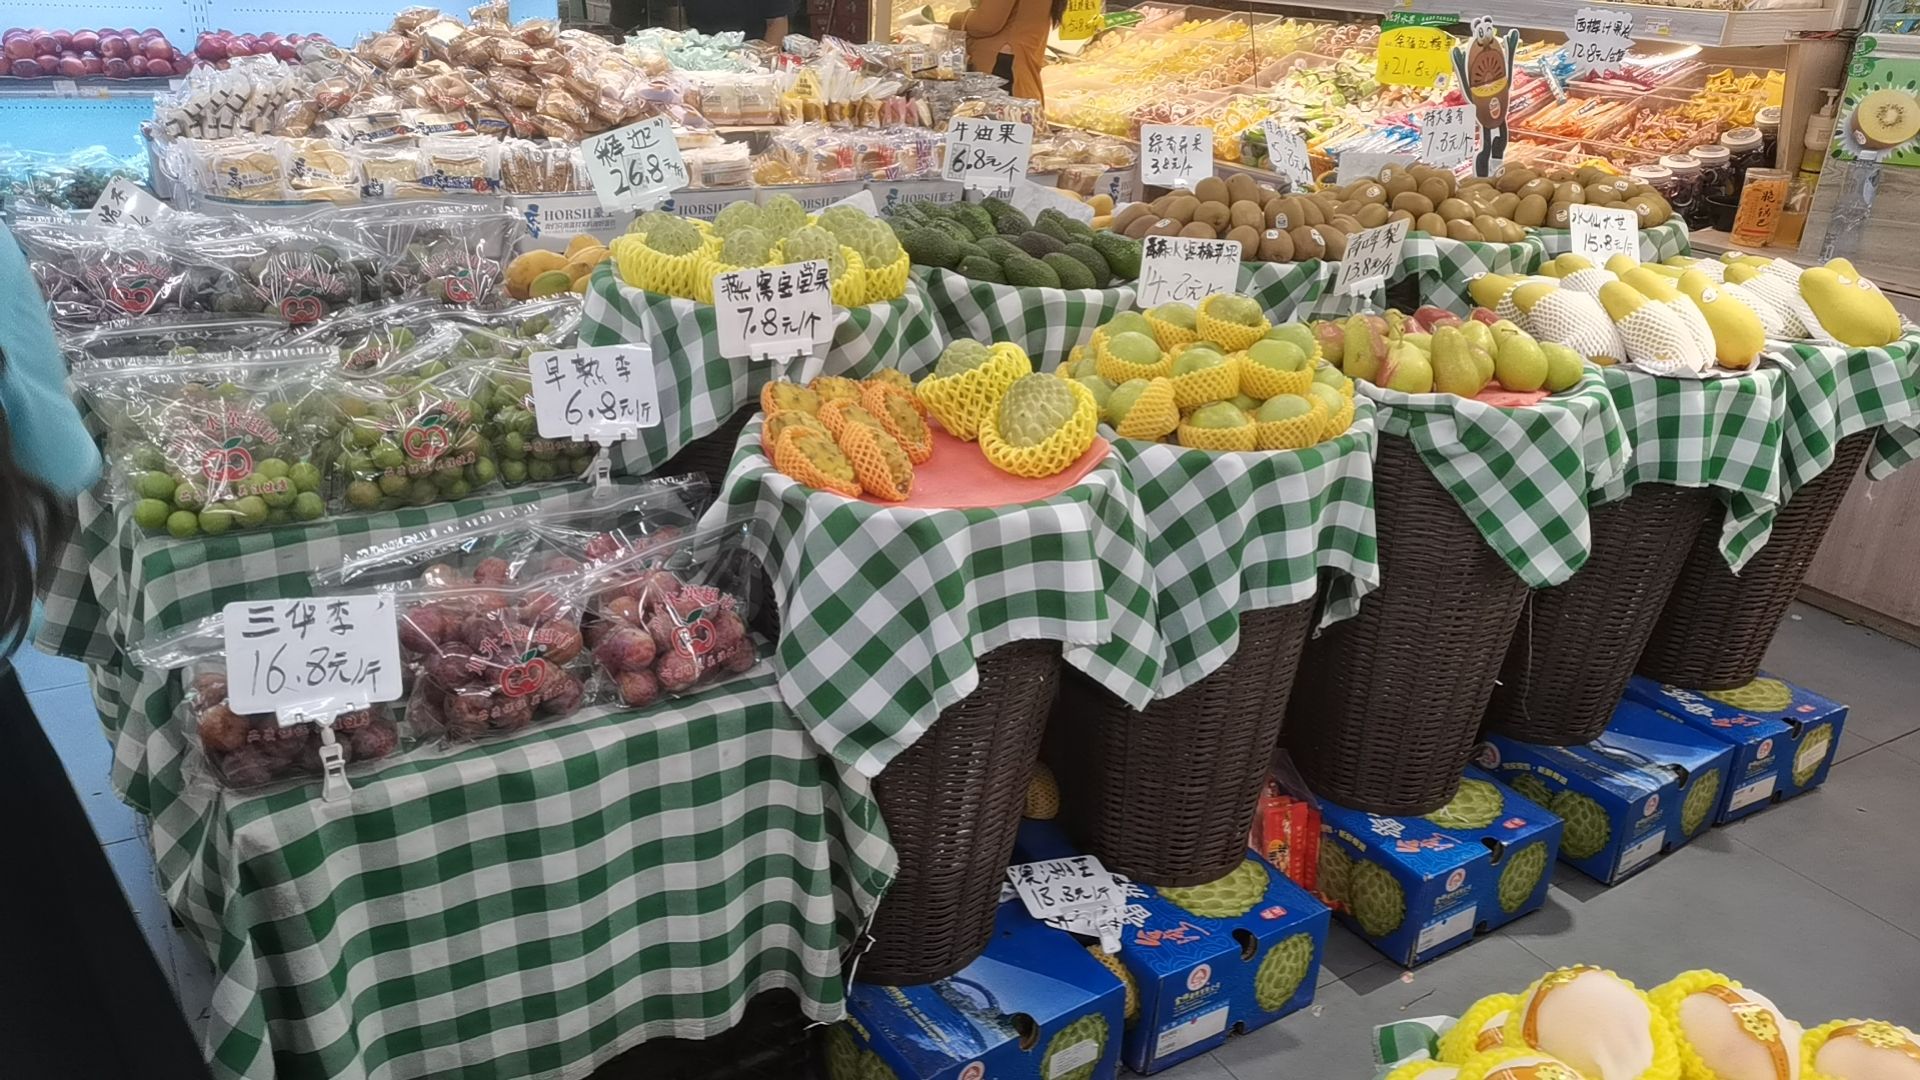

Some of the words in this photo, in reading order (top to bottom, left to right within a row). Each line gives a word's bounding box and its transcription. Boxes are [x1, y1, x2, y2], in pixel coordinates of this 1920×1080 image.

[952, 121, 1023, 144] 牛油果
[737, 307, 821, 340] 7.8元/个
[565, 389, 651, 425] 6.8元/斤
[242, 601, 354, 640] 三华李
[251, 643, 381, 696] 16.8元/斤
